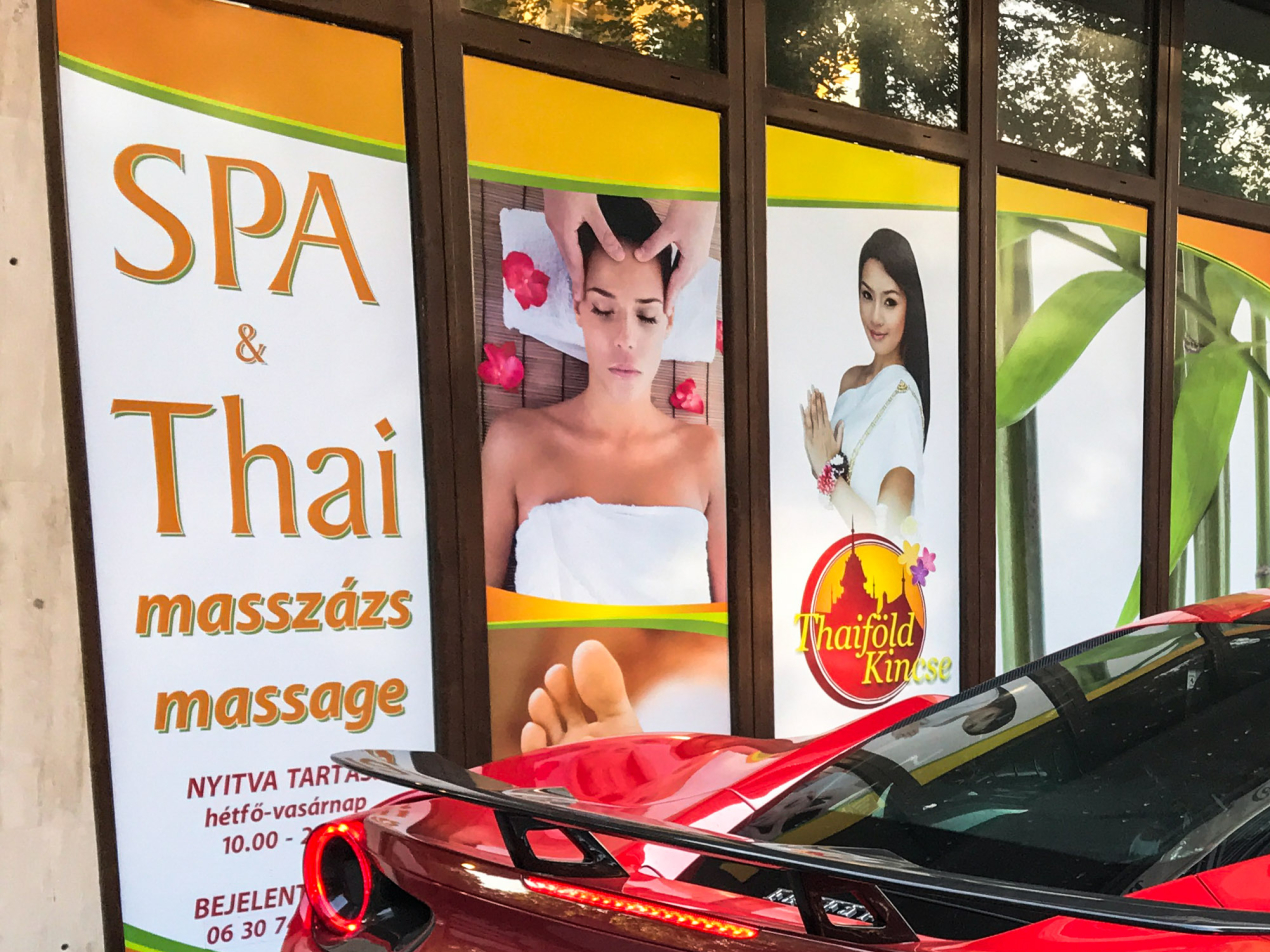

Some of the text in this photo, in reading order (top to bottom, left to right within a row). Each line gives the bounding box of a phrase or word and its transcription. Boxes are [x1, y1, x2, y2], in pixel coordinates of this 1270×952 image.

[113, 143, 380, 306] SPA
[235, 323, 268, 365] &
[110, 394, 403, 539] Thai
[135, 576, 413, 637] masszázs
[794, 609, 916, 658] Thaiföld
[862, 649, 953, 686] Kincse
[153, 677, 409, 734] massage
[186, 770, 278, 800] NYITVA
[204, 796, 367, 828] hétfő-vasárnap
[222, 831, 279, 854] 10.00
[206, 924, 233, 945] 06
[240, 919, 267, 940] 30
